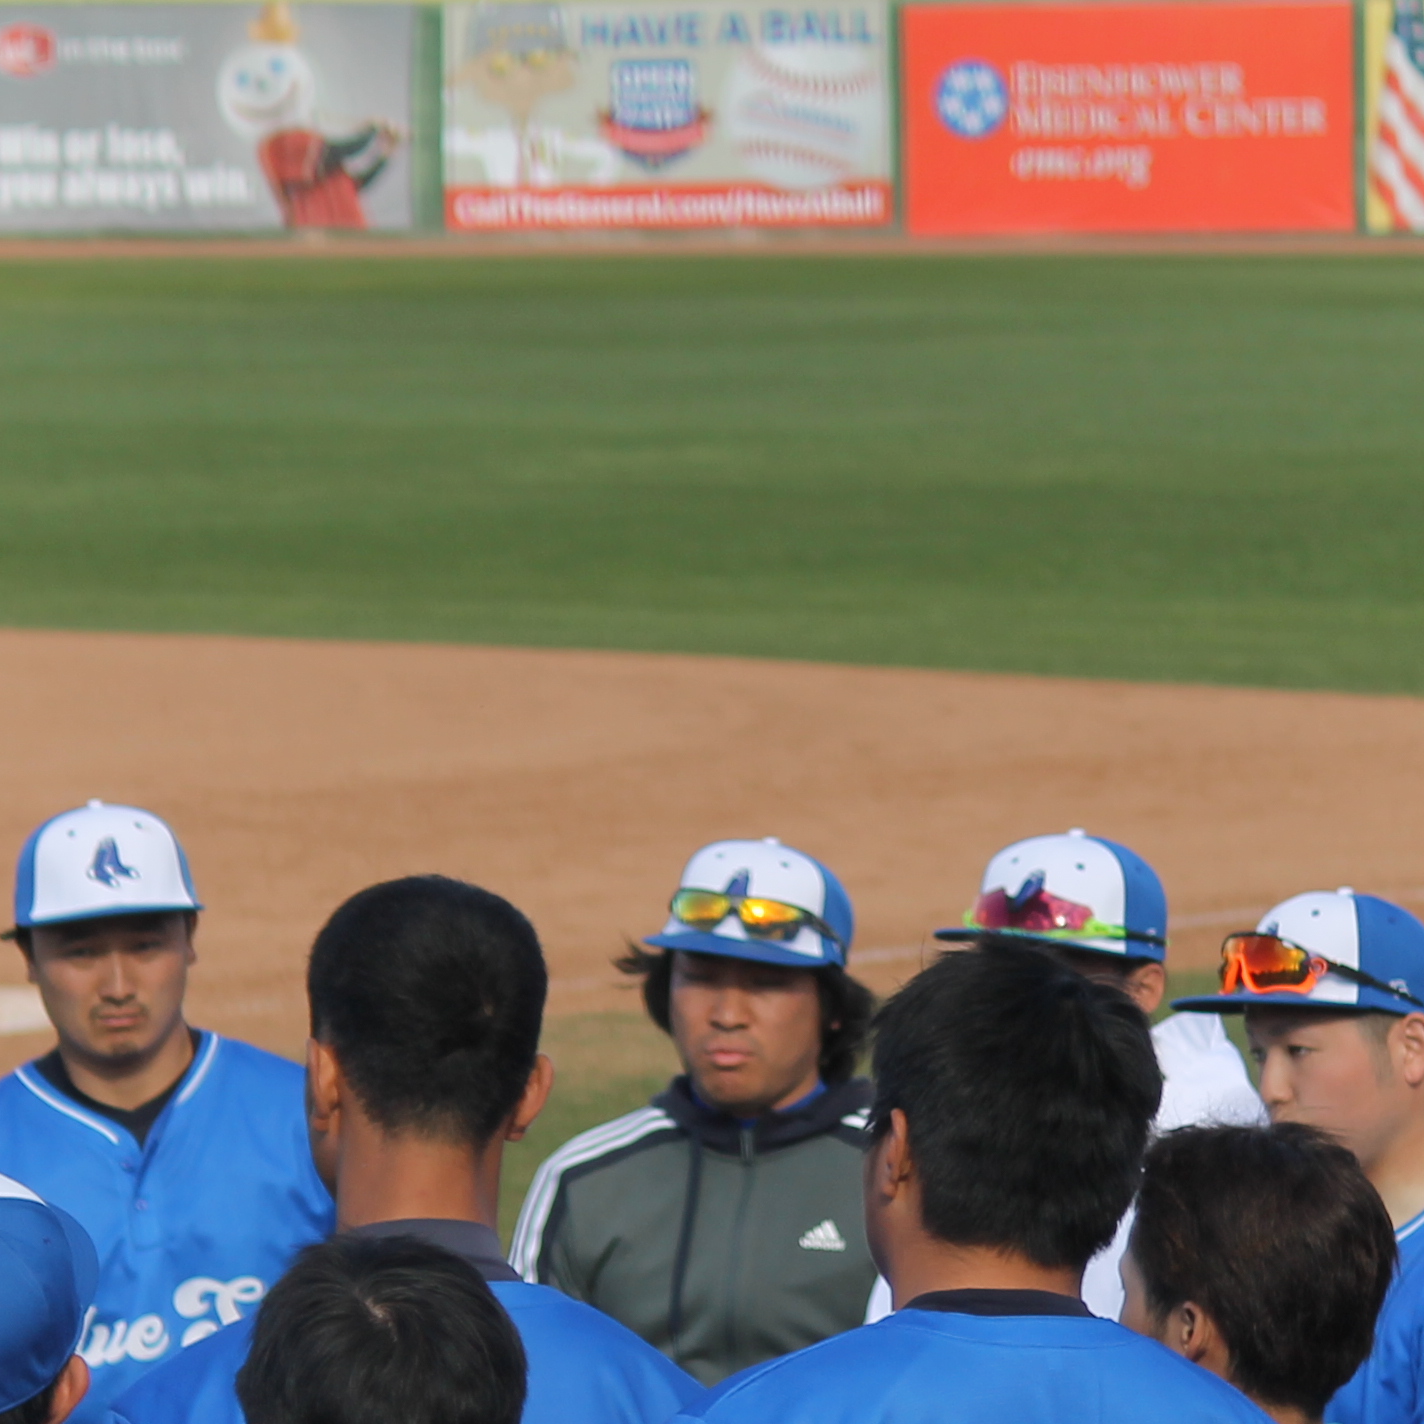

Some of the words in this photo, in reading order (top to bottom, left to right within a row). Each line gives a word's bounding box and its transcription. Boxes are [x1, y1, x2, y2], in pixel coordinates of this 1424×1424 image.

[579, 13, 703, 47] HAVE
[718, 11, 751, 45] A
[761, 8, 876, 46] BALL
[1011, 101, 1177, 138] MEDICAL
[1183, 96, 1328, 137] CENTER
[61, 167, 176, 213] always
